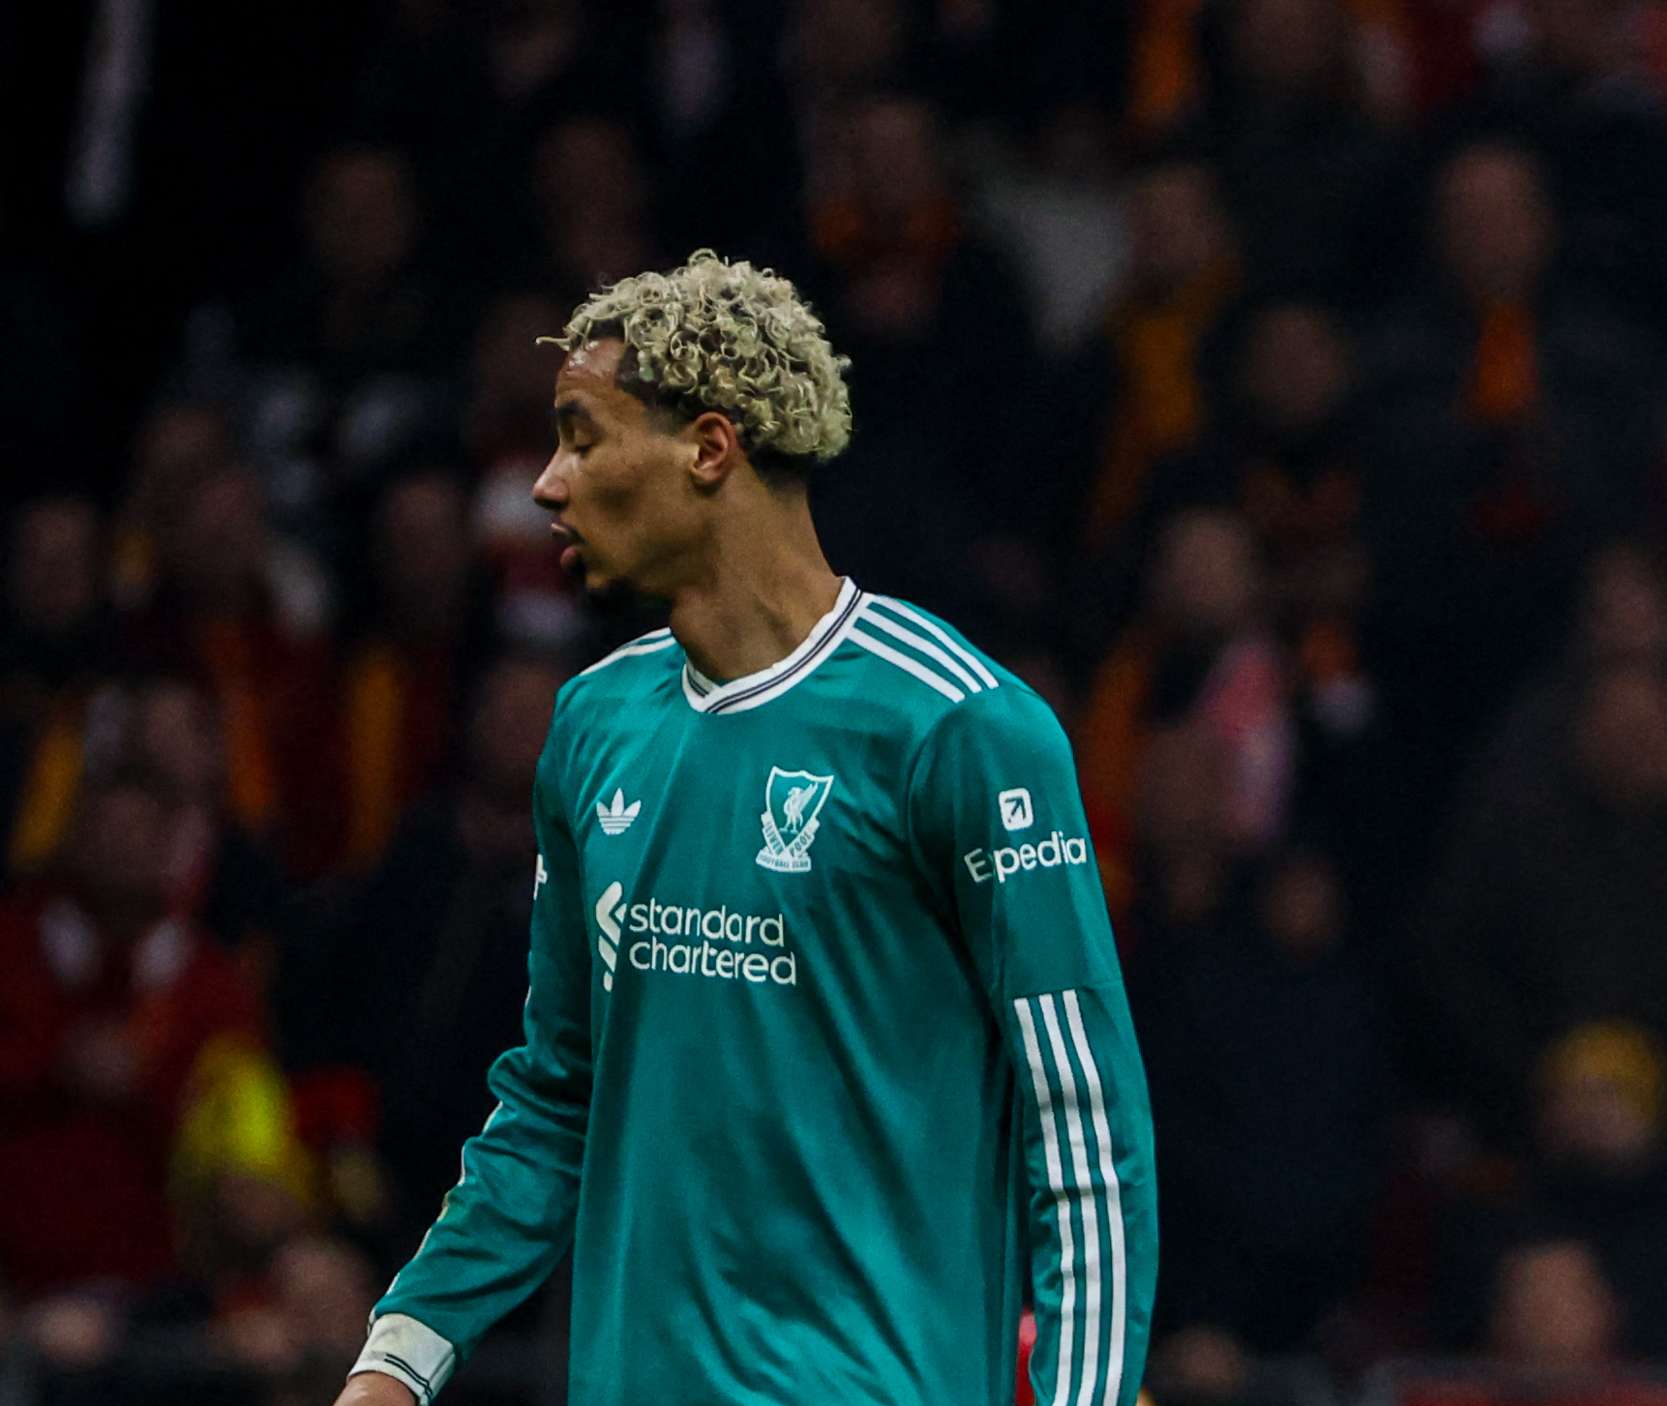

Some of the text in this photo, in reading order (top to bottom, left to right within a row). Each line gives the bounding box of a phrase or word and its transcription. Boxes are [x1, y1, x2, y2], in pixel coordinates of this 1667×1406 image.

[964, 830, 1087, 883] Epedia
[629, 897, 784, 947] standard
[629, 936, 797, 986] chartered
